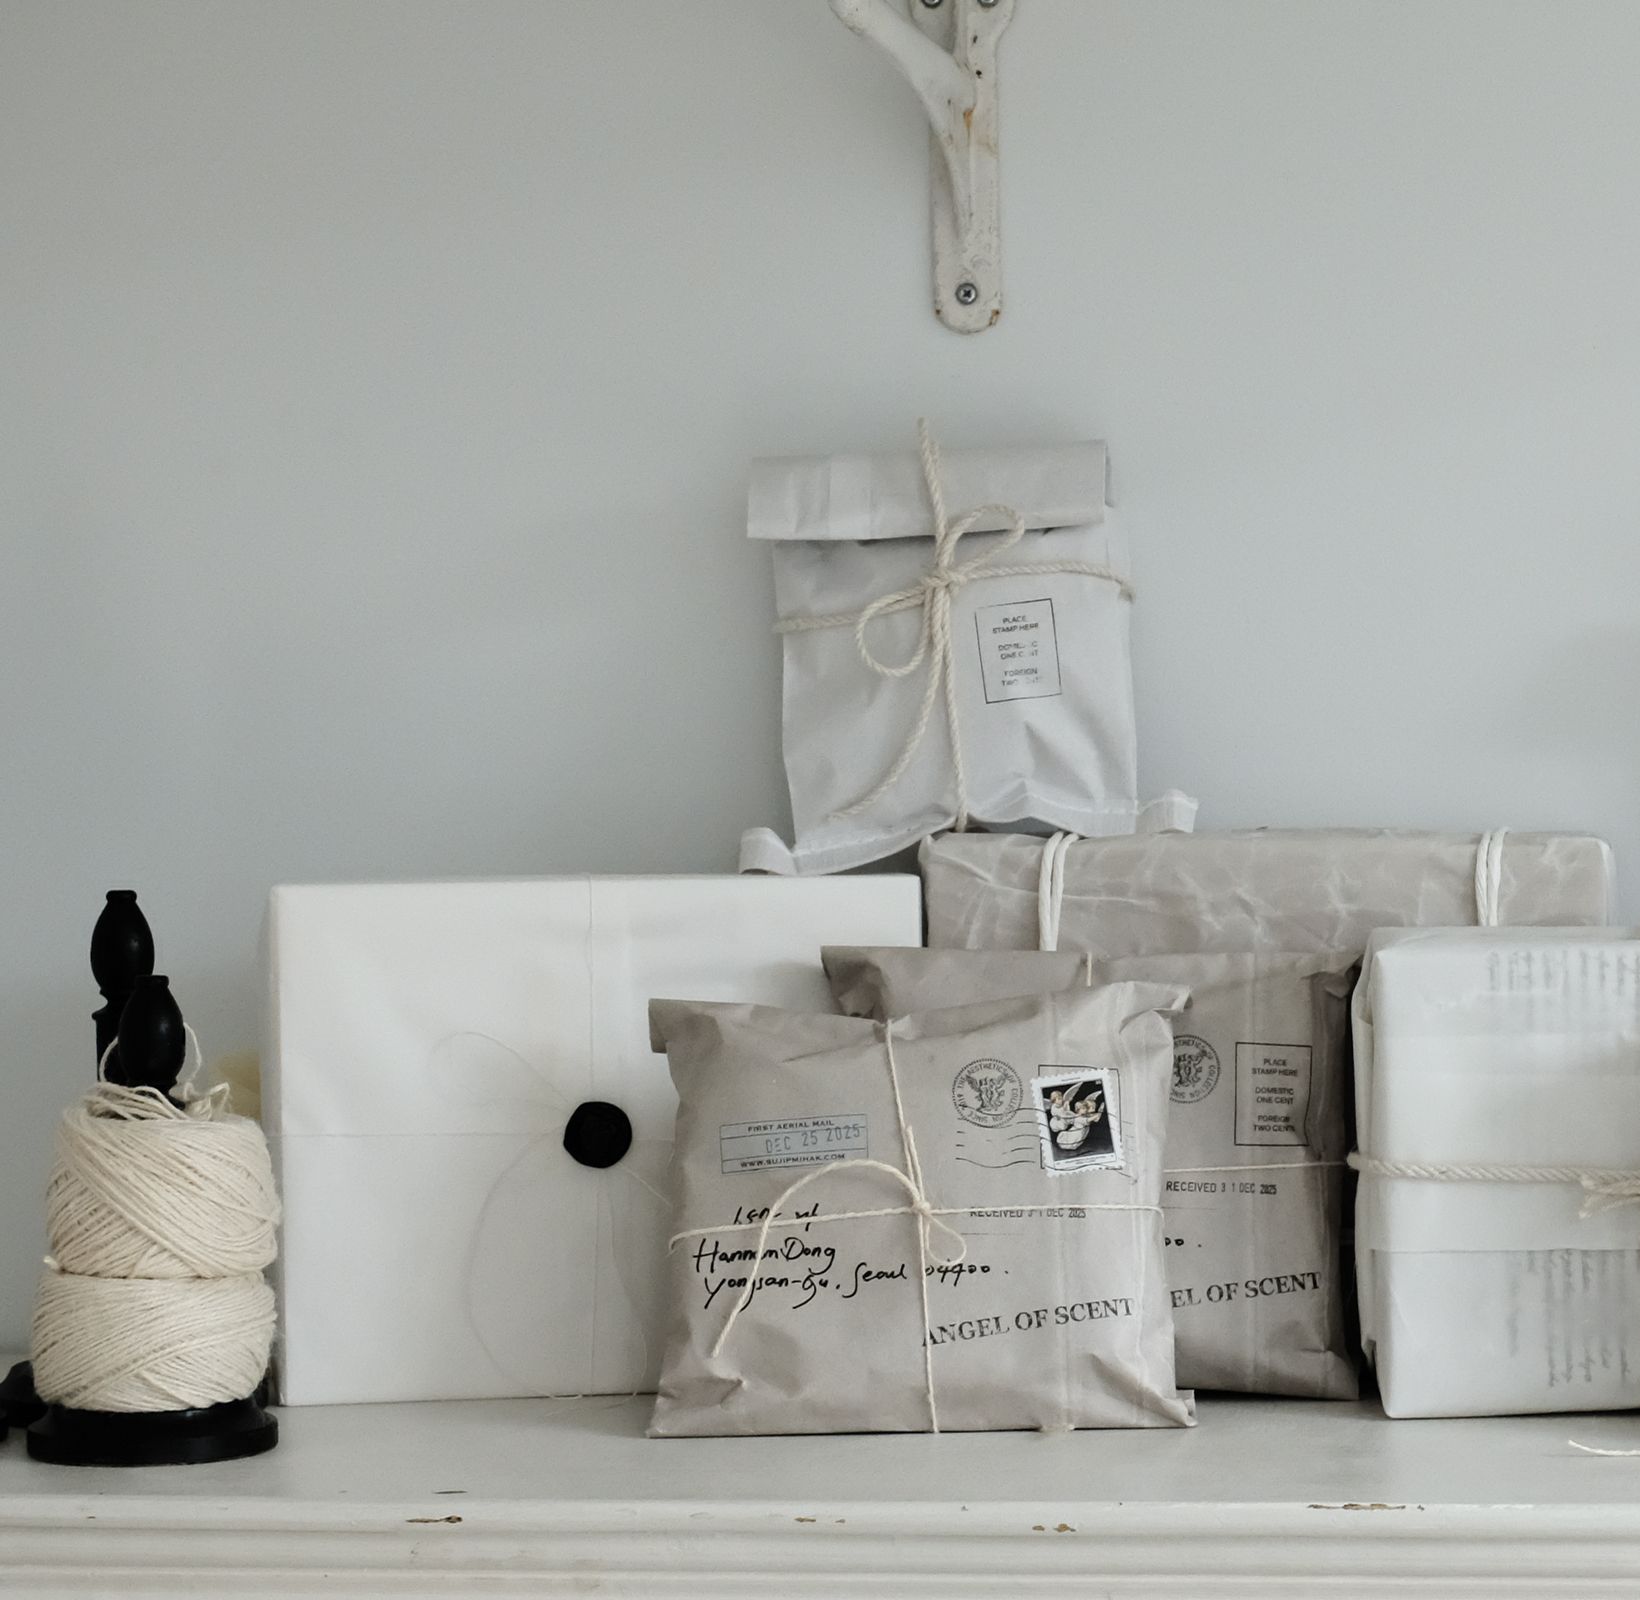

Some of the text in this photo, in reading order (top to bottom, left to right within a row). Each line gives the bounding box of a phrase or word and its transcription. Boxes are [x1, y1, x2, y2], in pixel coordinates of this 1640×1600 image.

[1002, 615, 1026, 624] PLACE
[992, 625, 1018, 634] STAMP
[1263, 1058, 1287, 1066] PLACE
[1251, 1067, 1298, 1077] STAMP HERE
[1255, 1086, 1294, 1095] DOMESTIC
[1256, 1096, 1294, 1105] ONE CENT
[1257, 1114, 1290, 1123] FOREIGN
[747, 1119, 835, 1132] FIRST AERIAL MAIL
[1253, 1124, 1271, 1132] TWO
[765, 1123, 861, 1154] DEC 25 2025
[1165, 1181, 1217, 1193] RECEIVED
[1239, 1183, 1256, 1194] DEC
[1260, 1184, 1277, 1195] 2025
[1046, 1207, 1064, 1218] DEC
[842, 1261, 908, 1299] Seoul
[1206, 1282, 1239, 1303] OF
[1244, 1271, 1321, 1299] SCENT
[922, 1297, 1136, 1347] ANGEL OF SCENT
